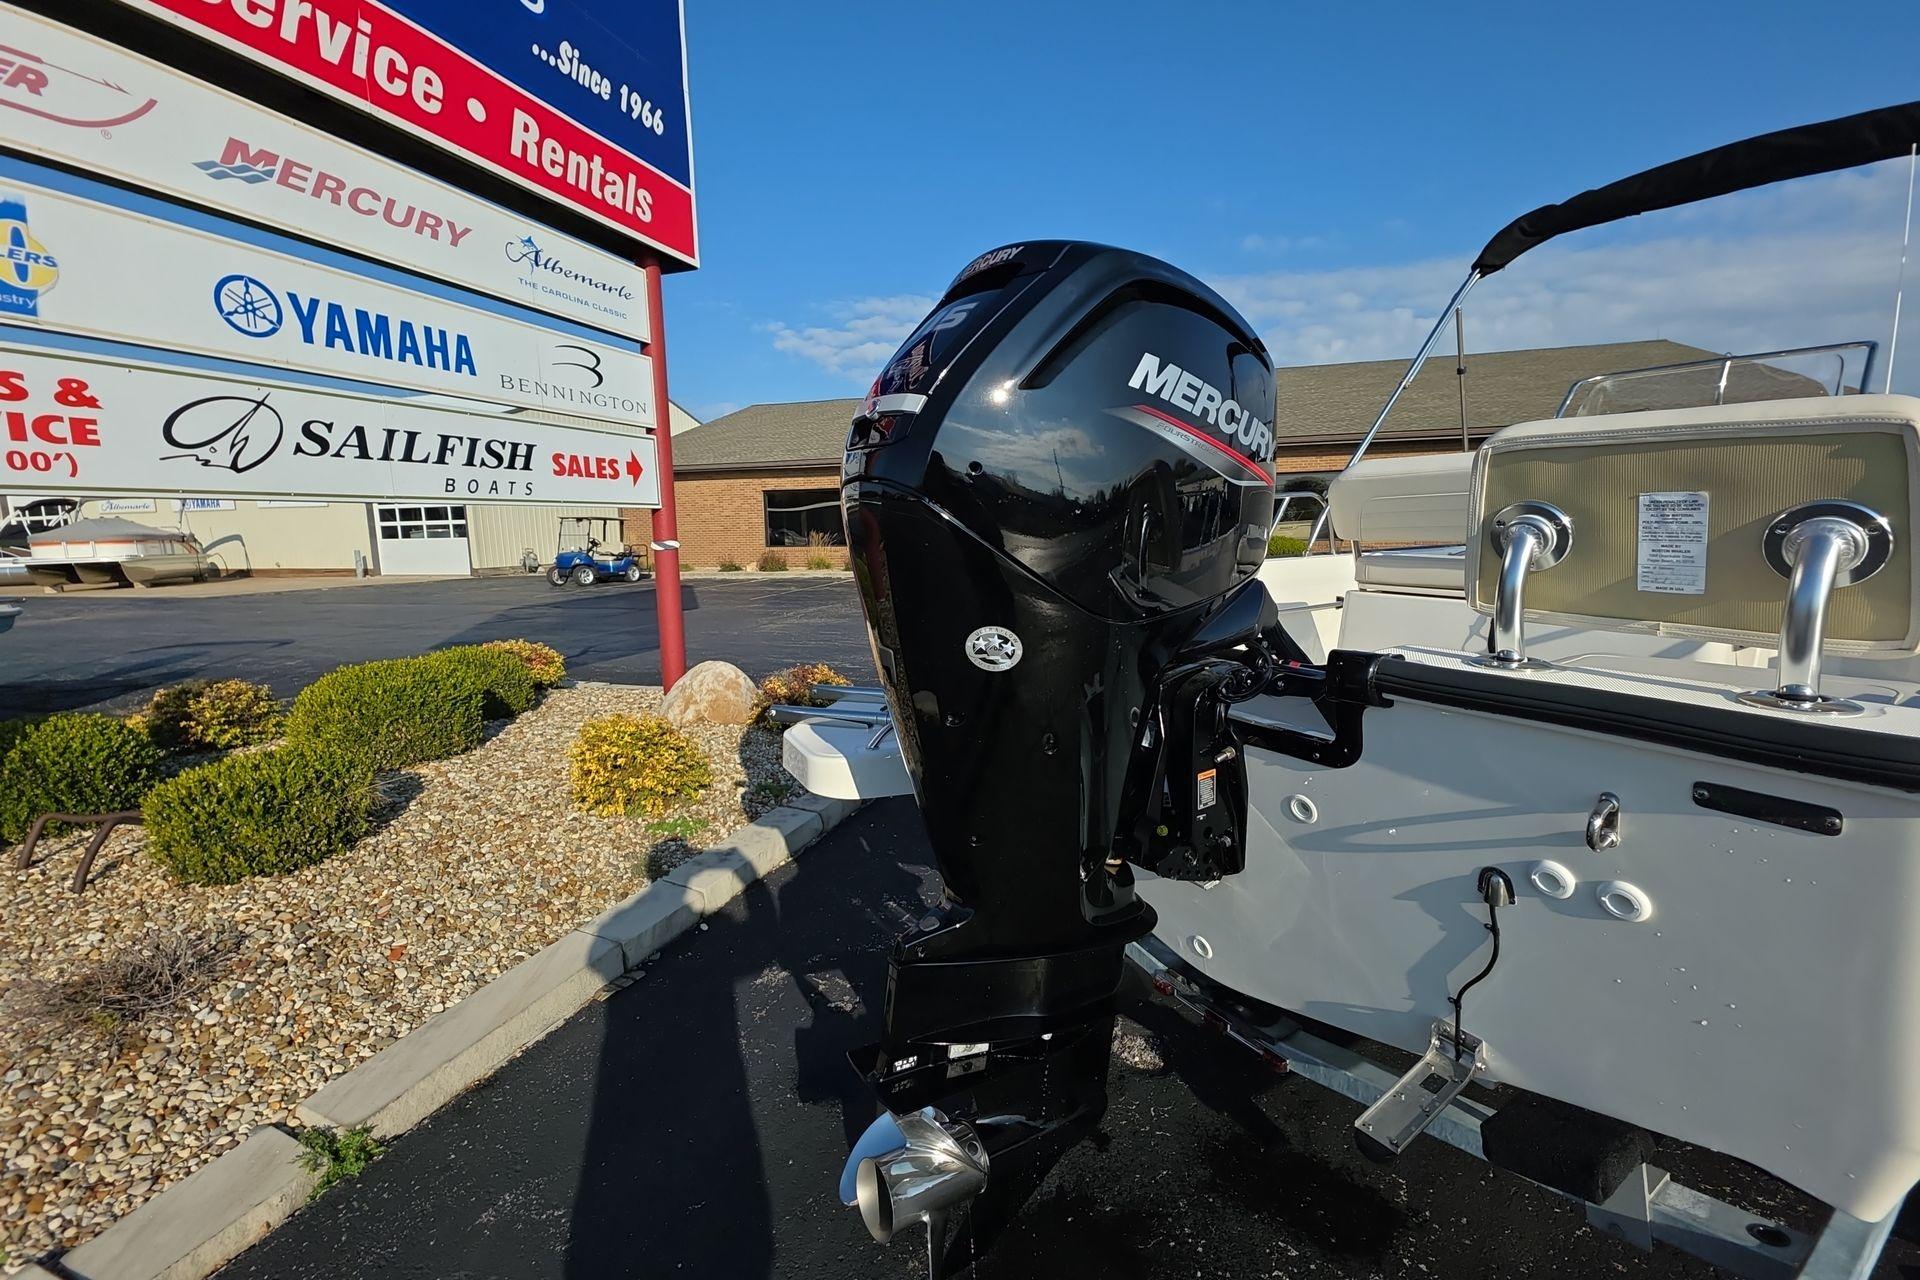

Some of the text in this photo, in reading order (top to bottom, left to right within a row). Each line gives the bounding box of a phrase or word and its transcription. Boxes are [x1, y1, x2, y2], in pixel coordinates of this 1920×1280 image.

[203, 0, 653, 223] ervice Rentals
[619, 84, 664, 136] 1966
[219, 137, 473, 248] MERCURY
[0, 247, 58, 268] ERS
[505, 240, 634, 301] Albemarle
[0, 291, 36, 309] stry
[518, 277, 628, 320] THE CAROLINA CLASSIC
[286, 291, 477, 376] YAMAHA
[54, 378, 104, 410] &
[500, 374, 648, 414] BENNINGTON
[1128, 352, 1277, 464] MERCURY
[0, 411, 101, 447] ICE
[293, 420, 538, 472] SAILFISH
[551, 452, 620, 480] SALES
[191, 499, 220, 509] YAMAHA
[444, 478, 534, 496] BOATS
